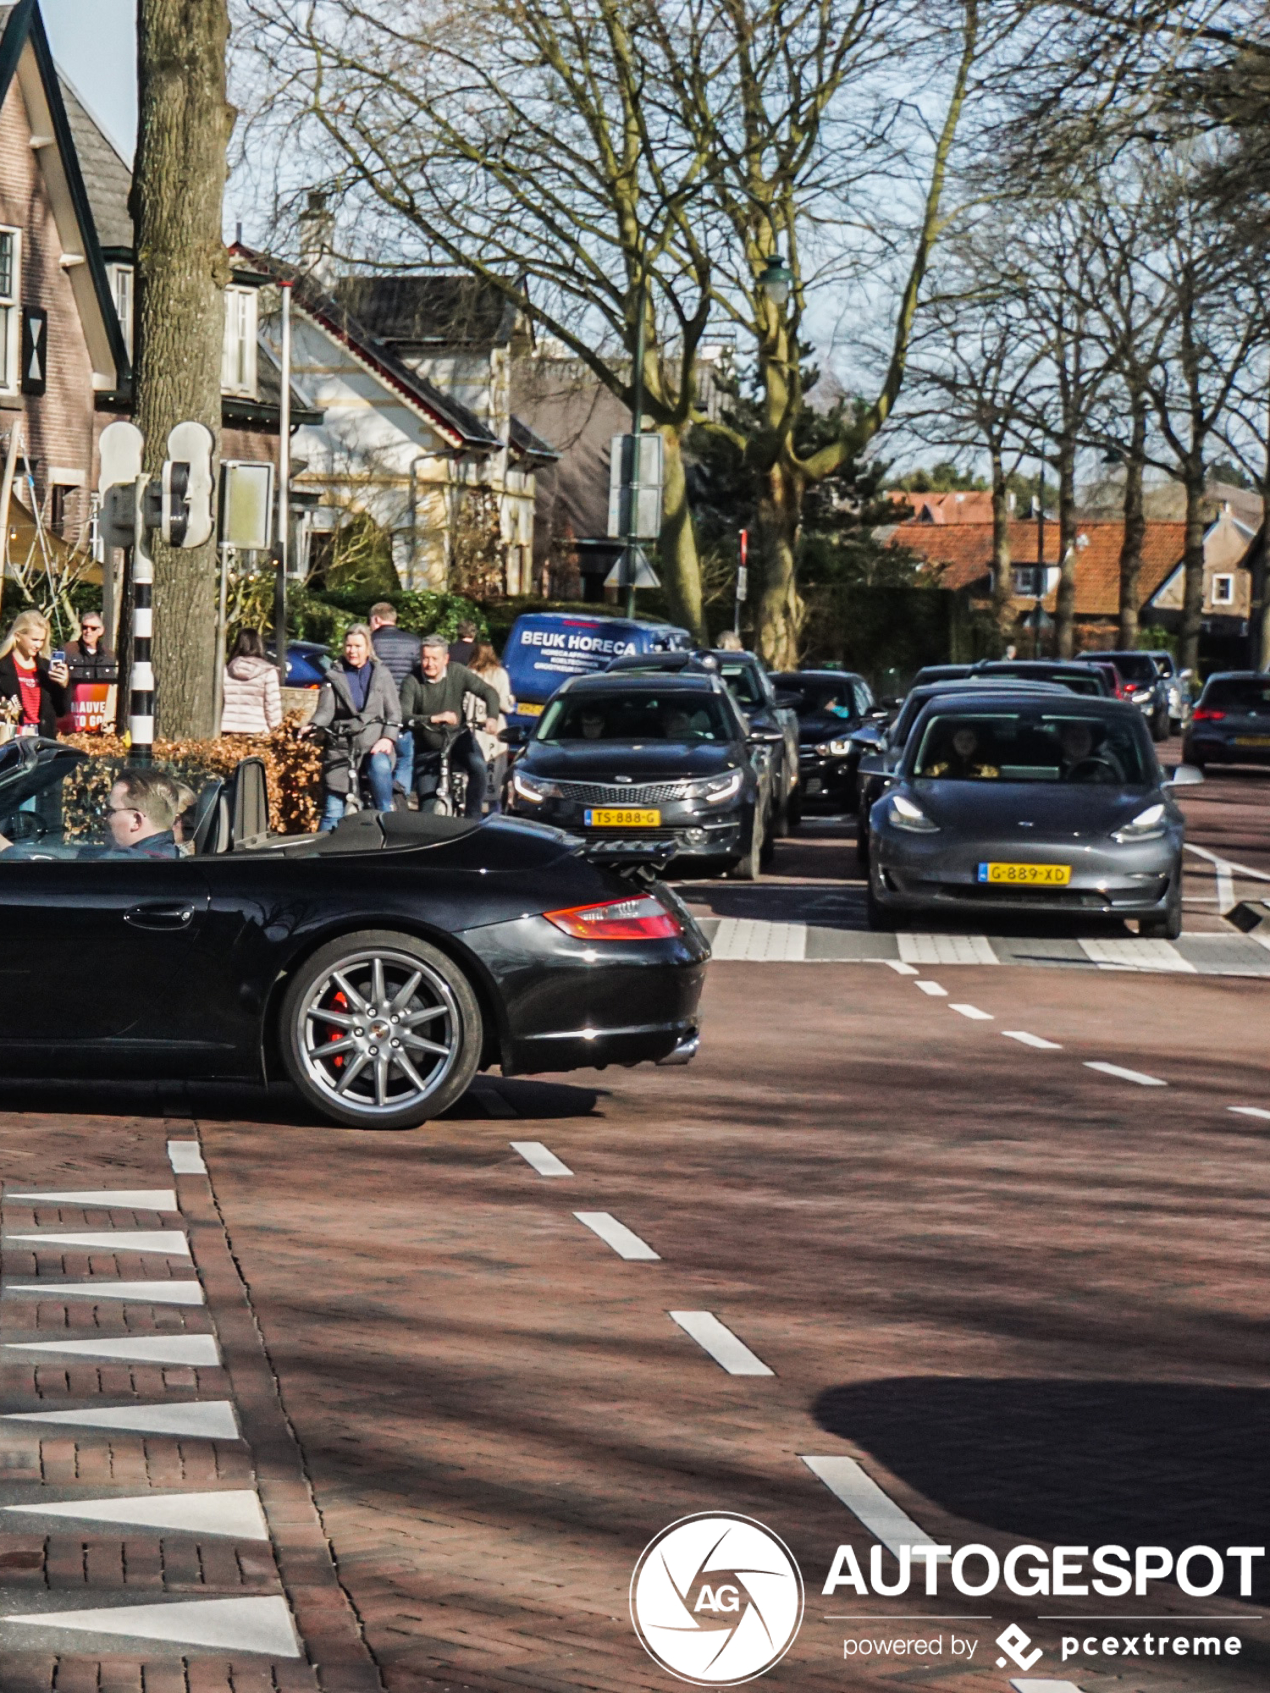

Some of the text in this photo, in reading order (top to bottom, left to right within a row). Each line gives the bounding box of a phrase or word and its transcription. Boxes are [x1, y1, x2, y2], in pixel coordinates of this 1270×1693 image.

[521, 630, 636, 655] BEUK HORECA
[71, 701, 106, 713] MAUVE
[74, 715, 86, 727] TO
[596, 812, 654, 823] TS-888-G
[991, 866, 1065, 881] G-889-XD
